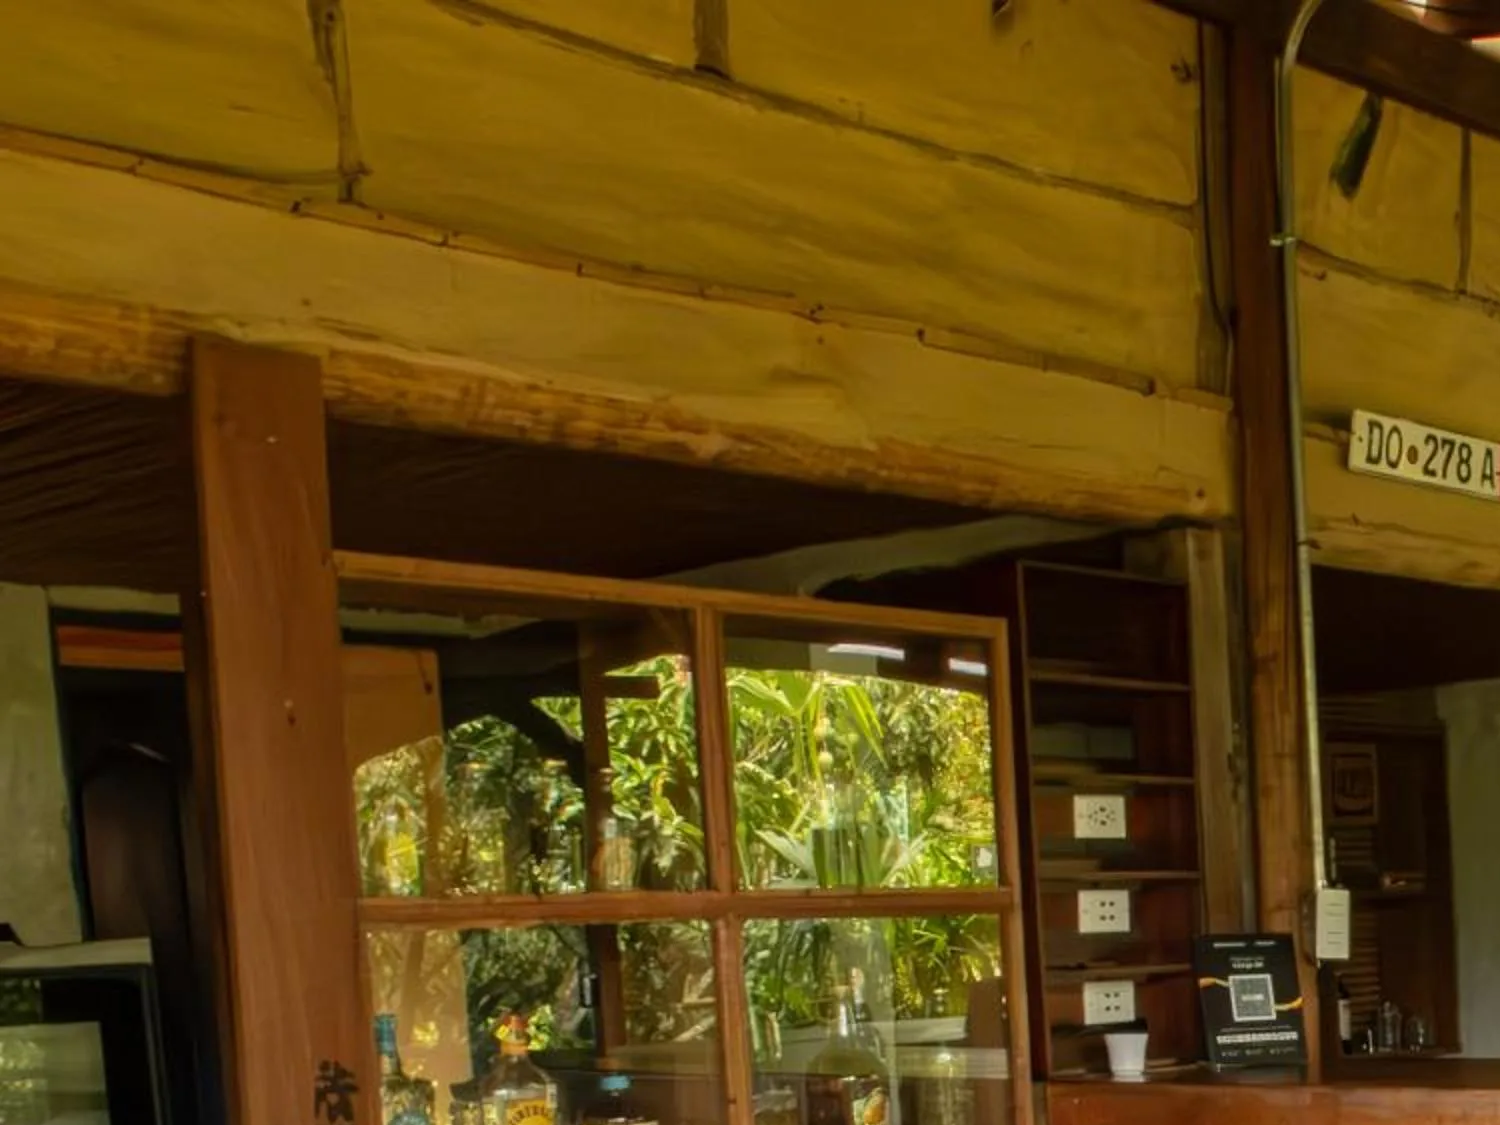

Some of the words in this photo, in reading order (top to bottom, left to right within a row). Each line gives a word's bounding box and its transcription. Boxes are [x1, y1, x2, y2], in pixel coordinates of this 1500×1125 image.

[1365, 419, 1403, 469] DO
[1422, 432, 1473, 484] 278
[1480, 446, 1497, 490] A
